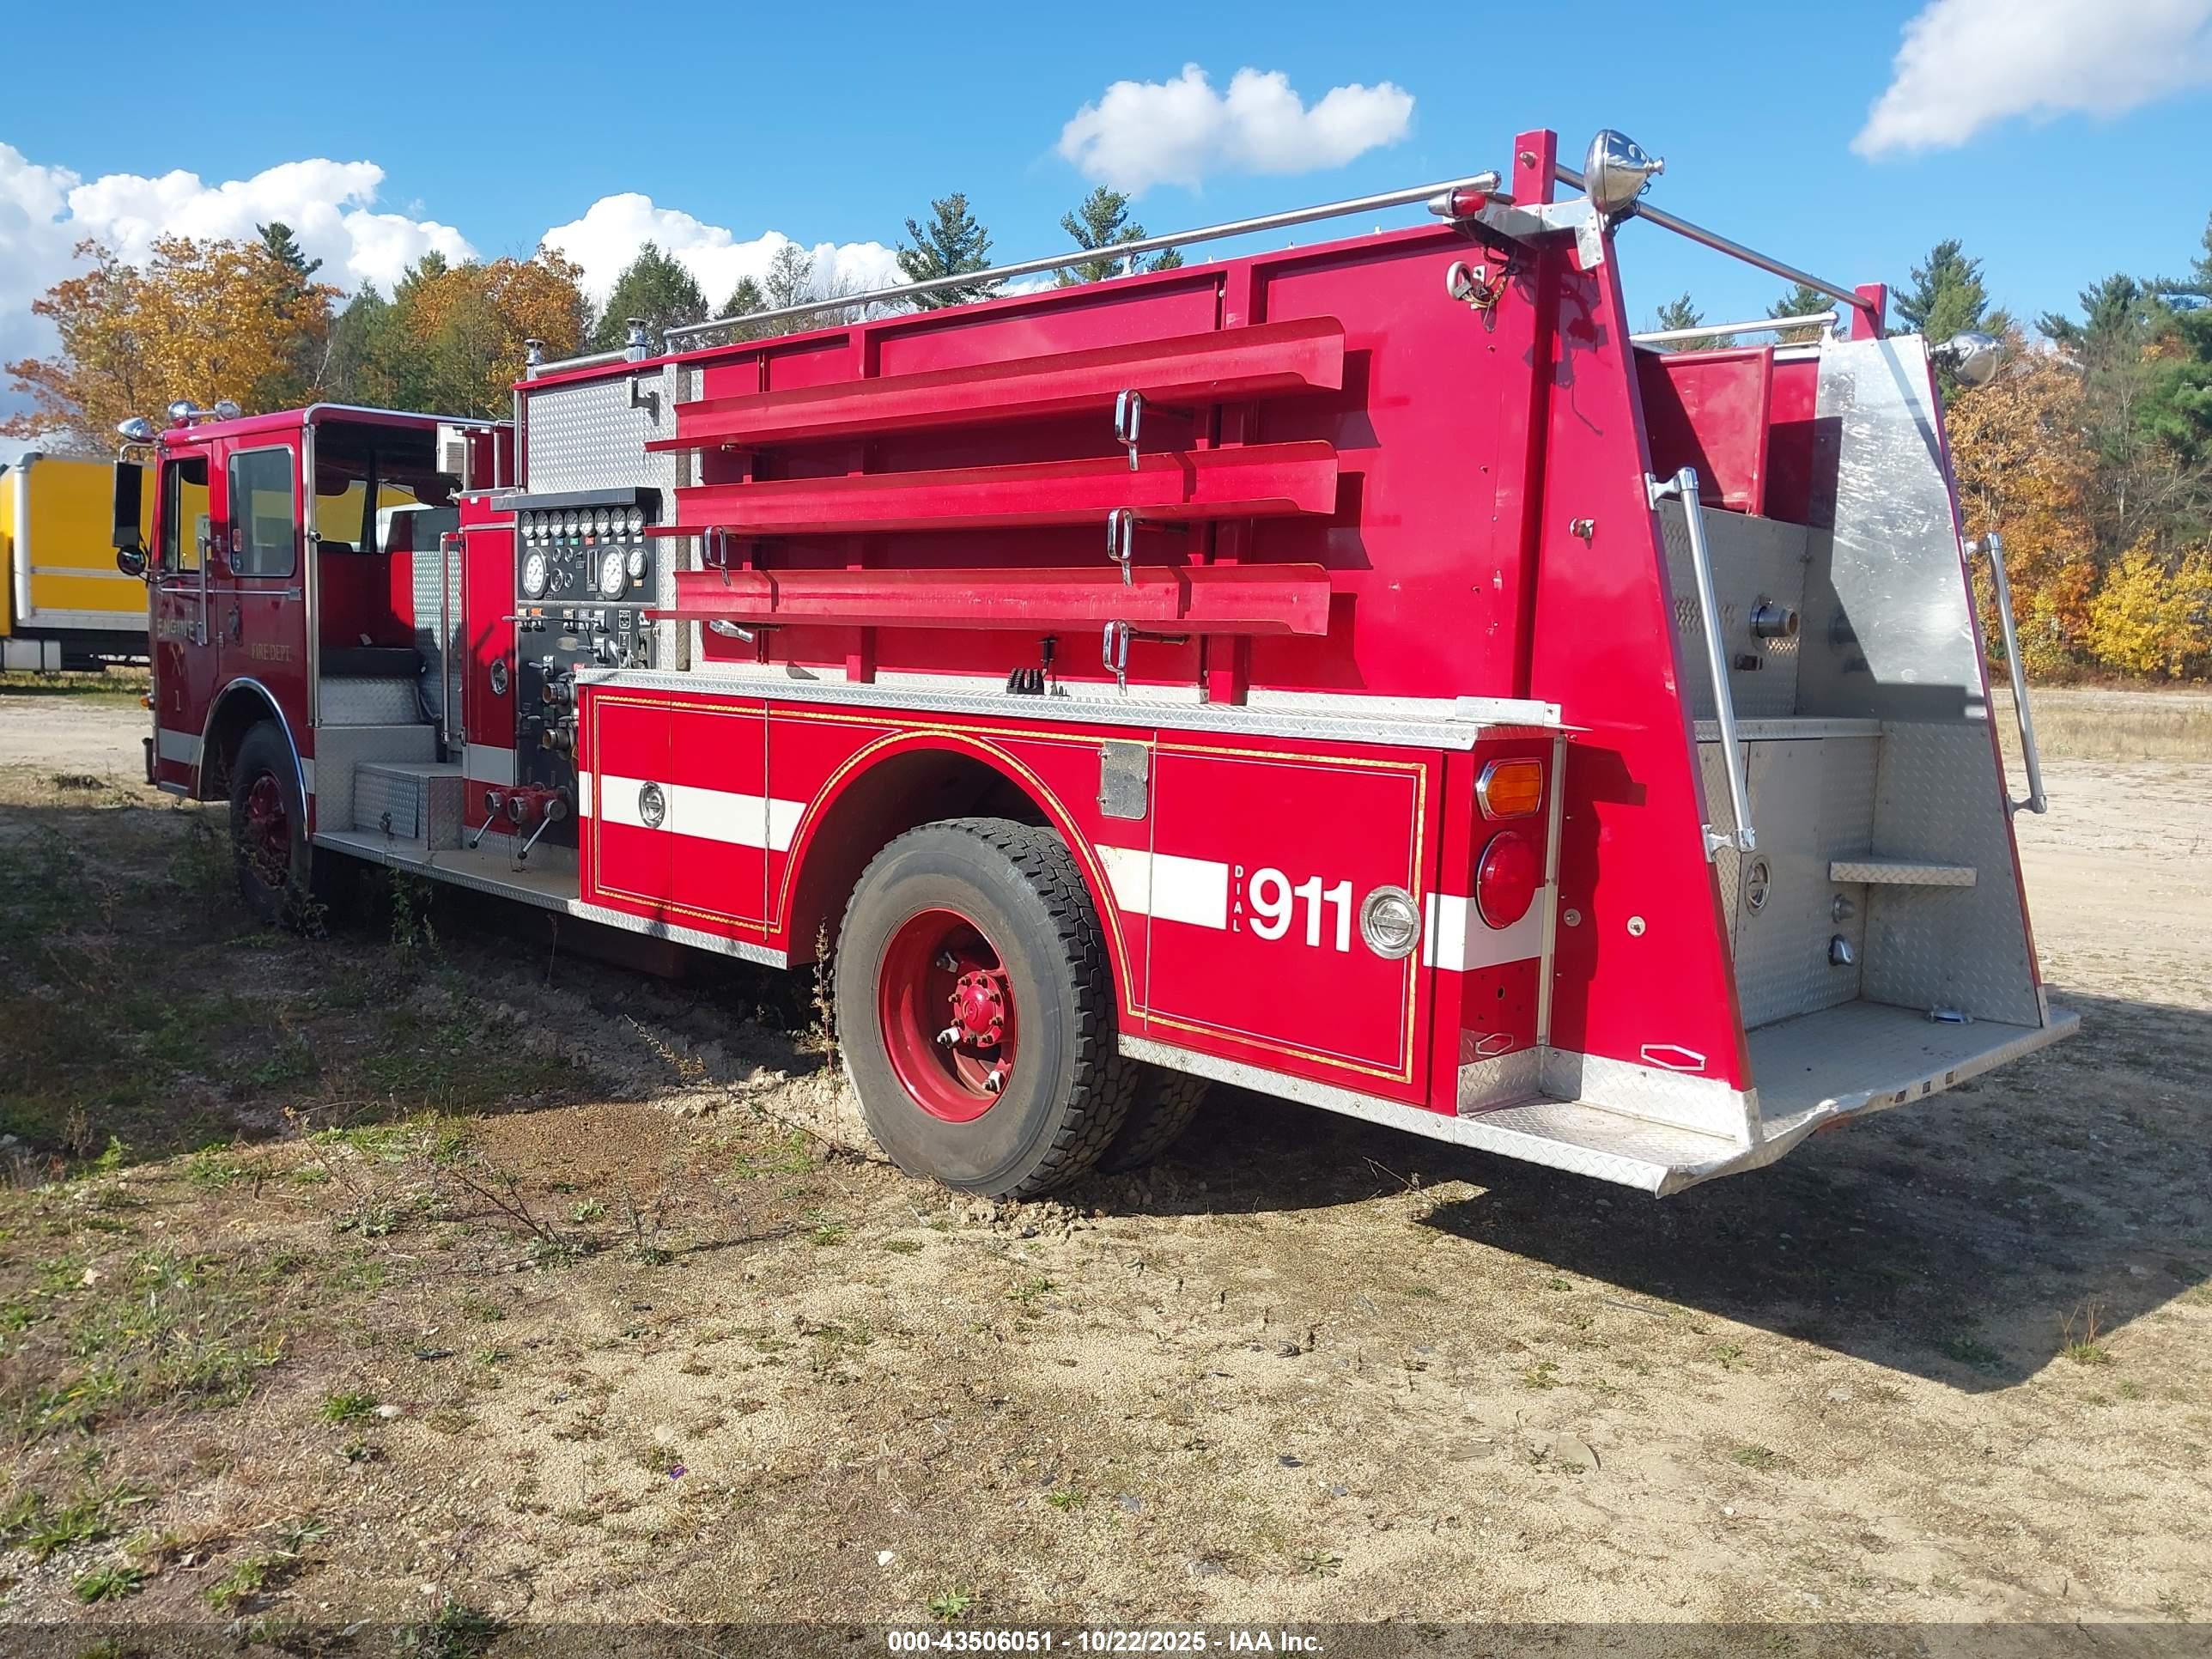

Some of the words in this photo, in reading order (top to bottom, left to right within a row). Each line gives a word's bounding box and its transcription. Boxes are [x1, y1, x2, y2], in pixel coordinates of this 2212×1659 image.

[157, 617, 195, 641] ENGINE
[251, 644, 270, 660] FIRE
[1232, 865, 1244, 933] DIAL
[1249, 867, 1353, 953] 911
